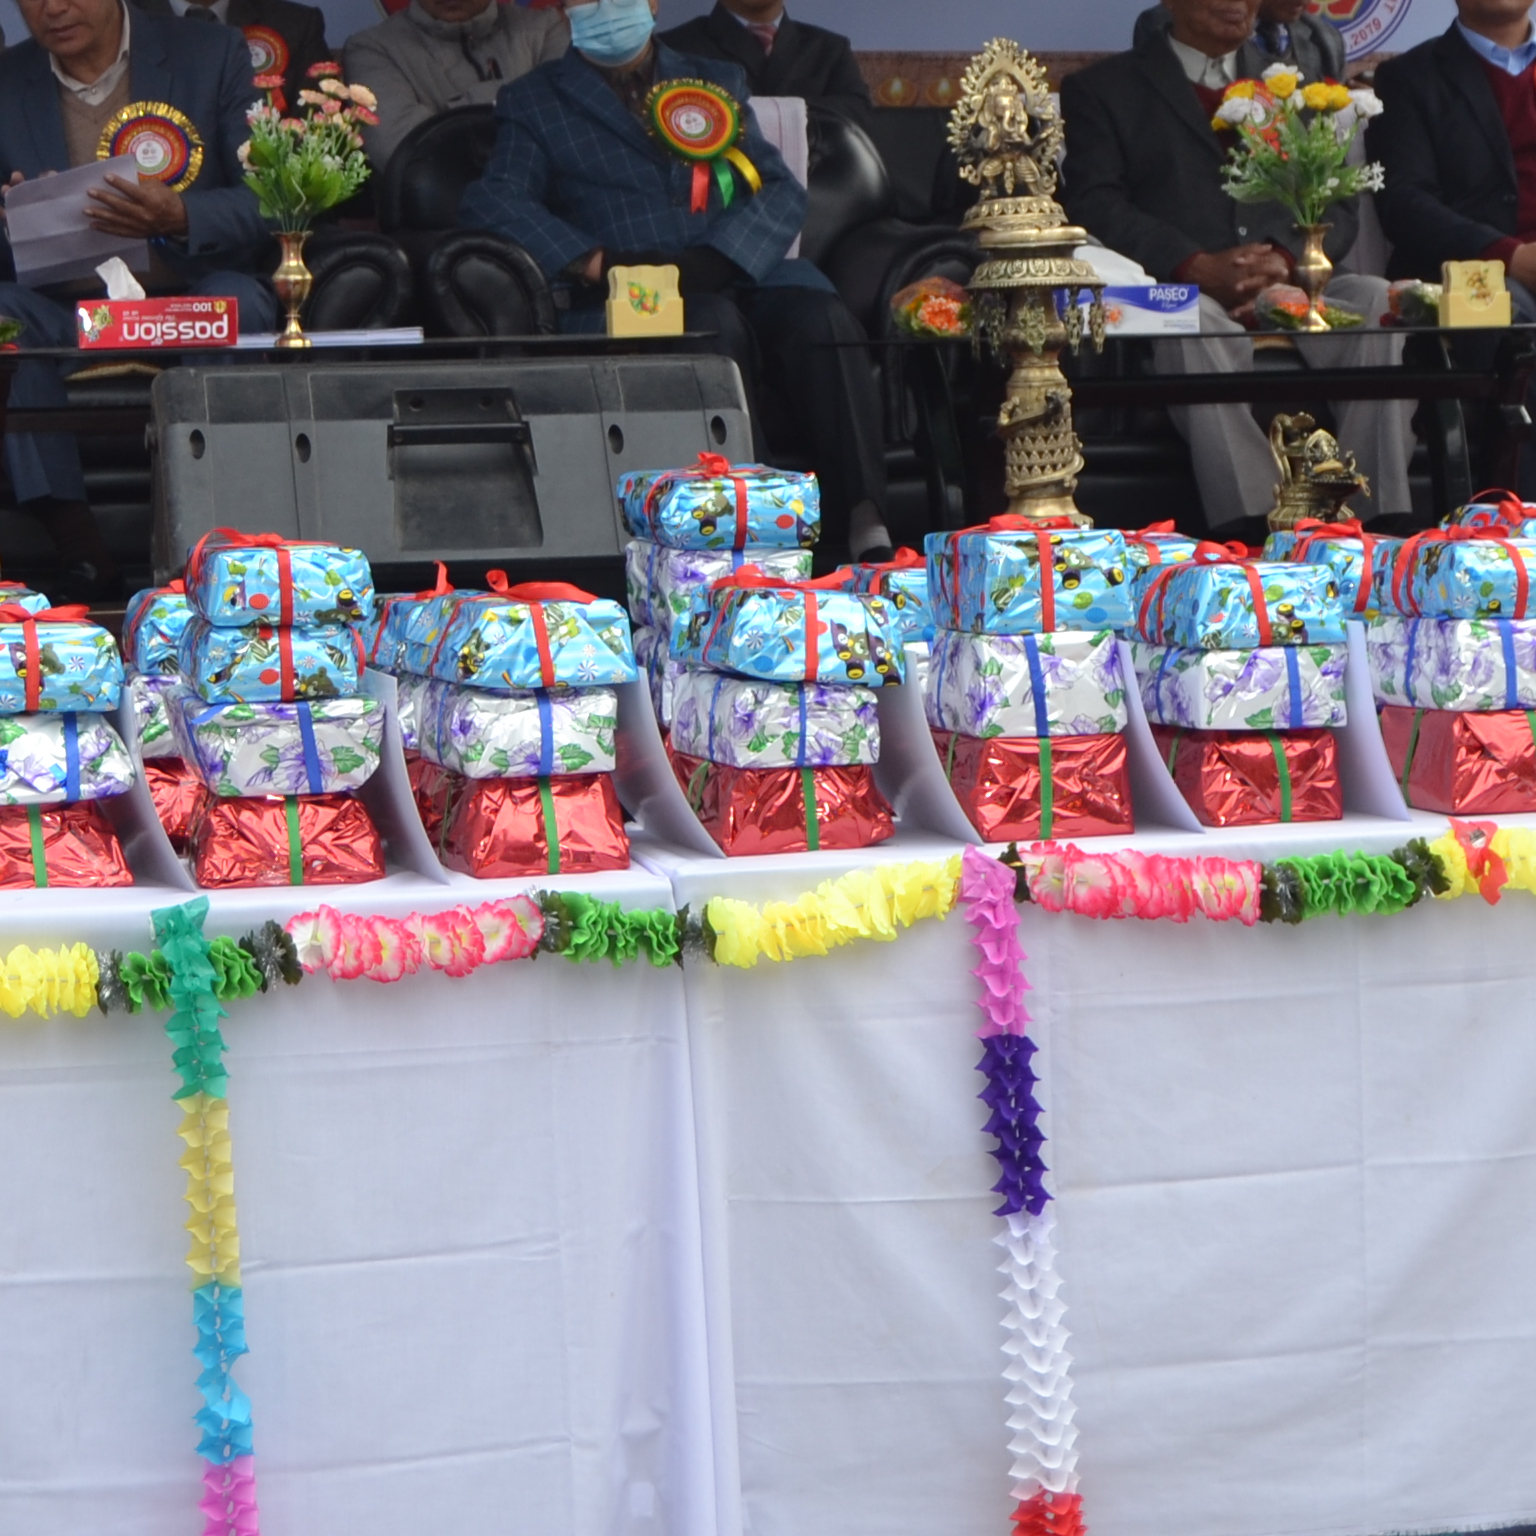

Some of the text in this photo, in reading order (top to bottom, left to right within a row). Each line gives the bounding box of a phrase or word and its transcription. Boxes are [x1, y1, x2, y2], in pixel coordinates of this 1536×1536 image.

[1148, 287, 1190, 302] PASEO
[192, 302, 213, 313] 100
[122, 313, 229, 343] passion
